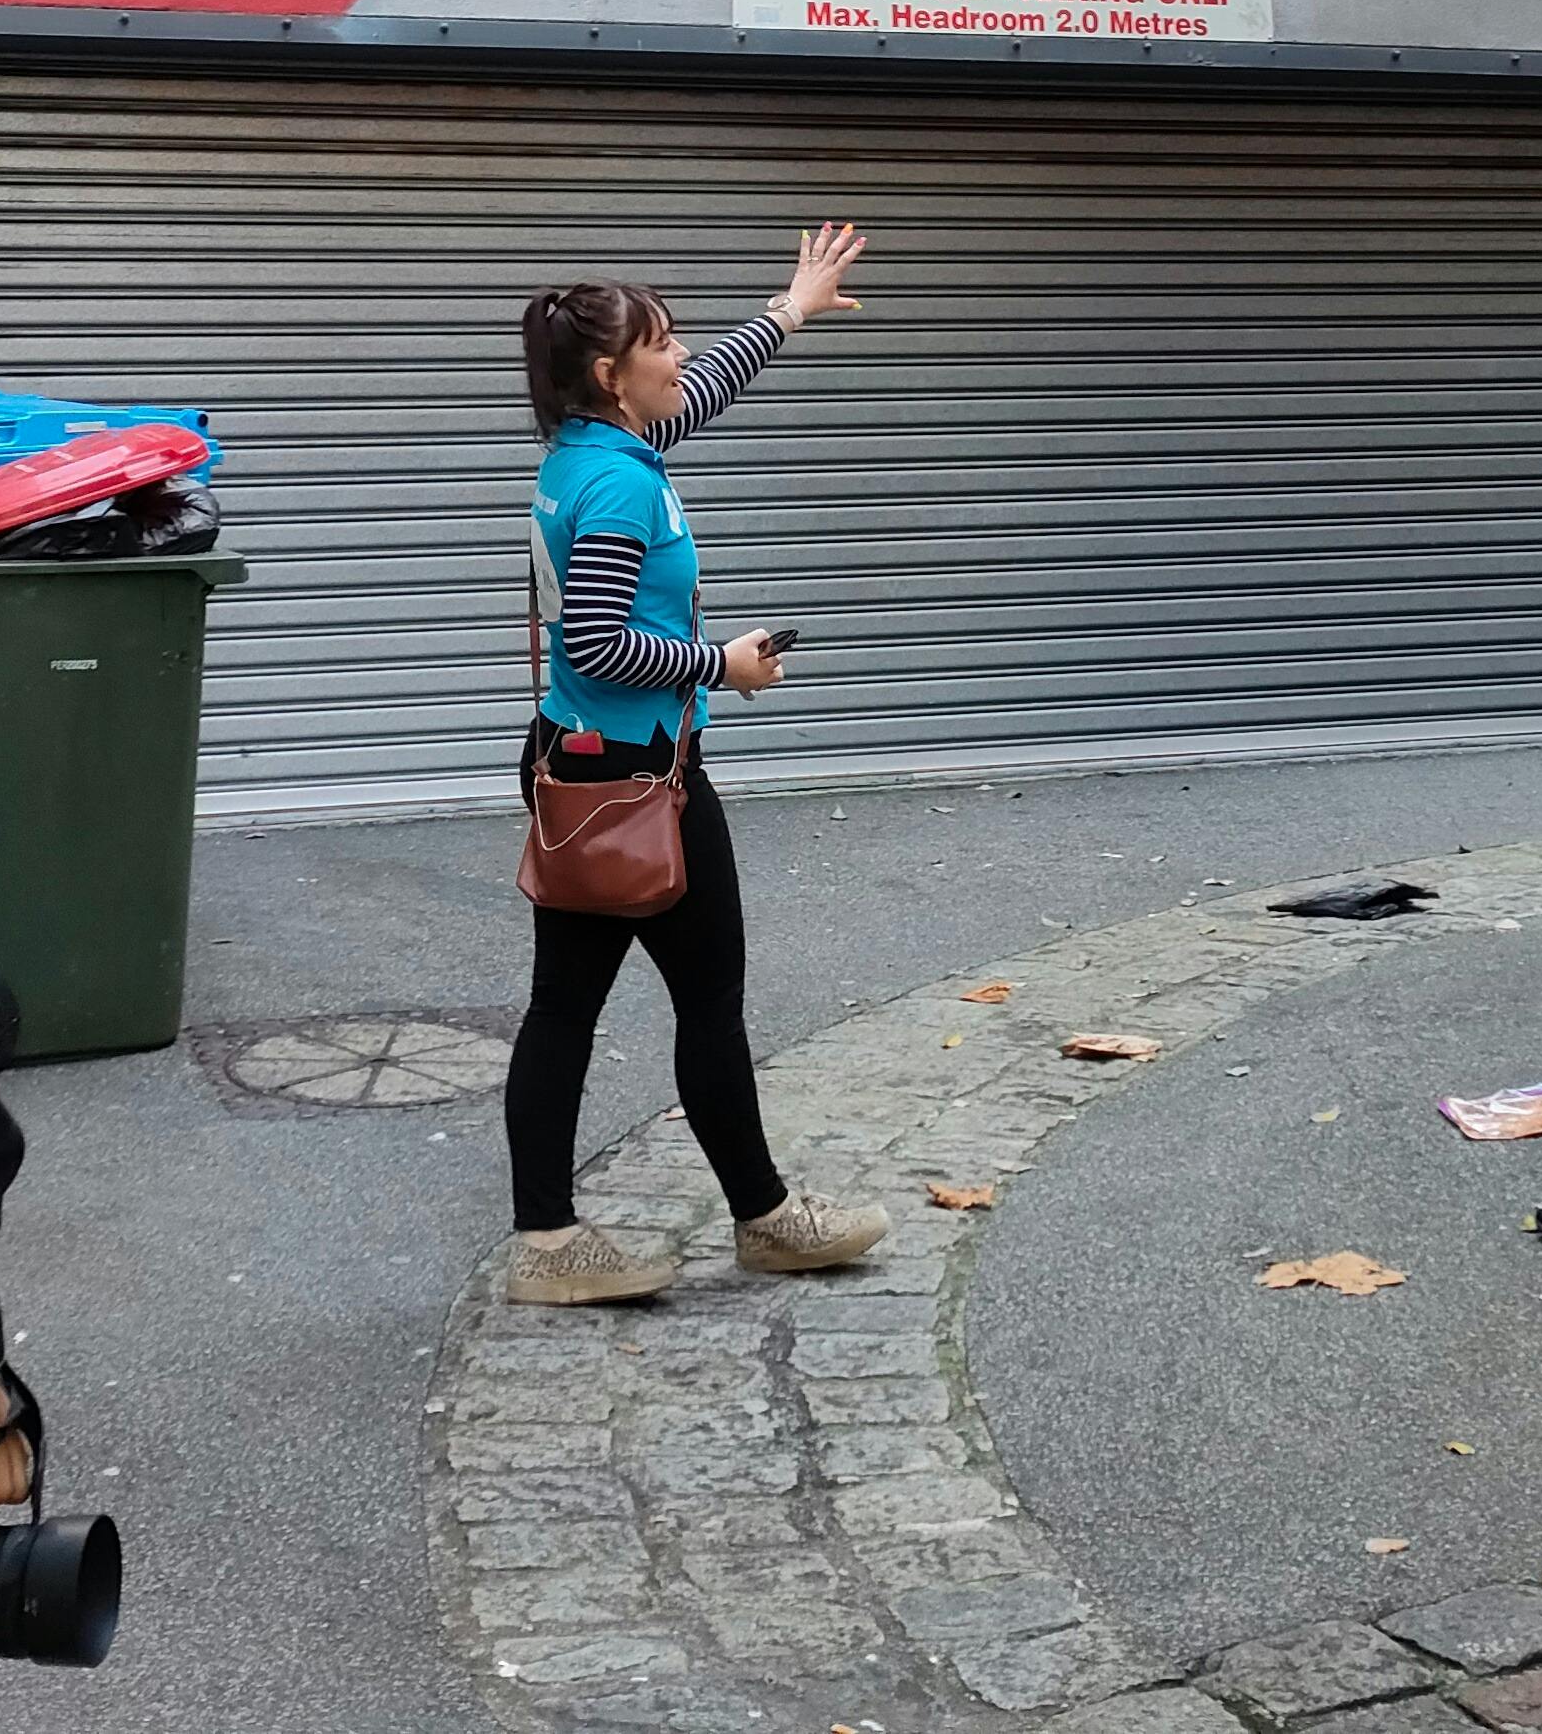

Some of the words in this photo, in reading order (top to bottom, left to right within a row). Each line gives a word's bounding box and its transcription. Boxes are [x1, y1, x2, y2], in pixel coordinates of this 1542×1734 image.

[806, 1, 880, 27] Max.
[891, 4, 1046, 32] Headroom
[1056, 9, 1099, 34] 2.0
[1109, 10, 1208, 37] Metres
